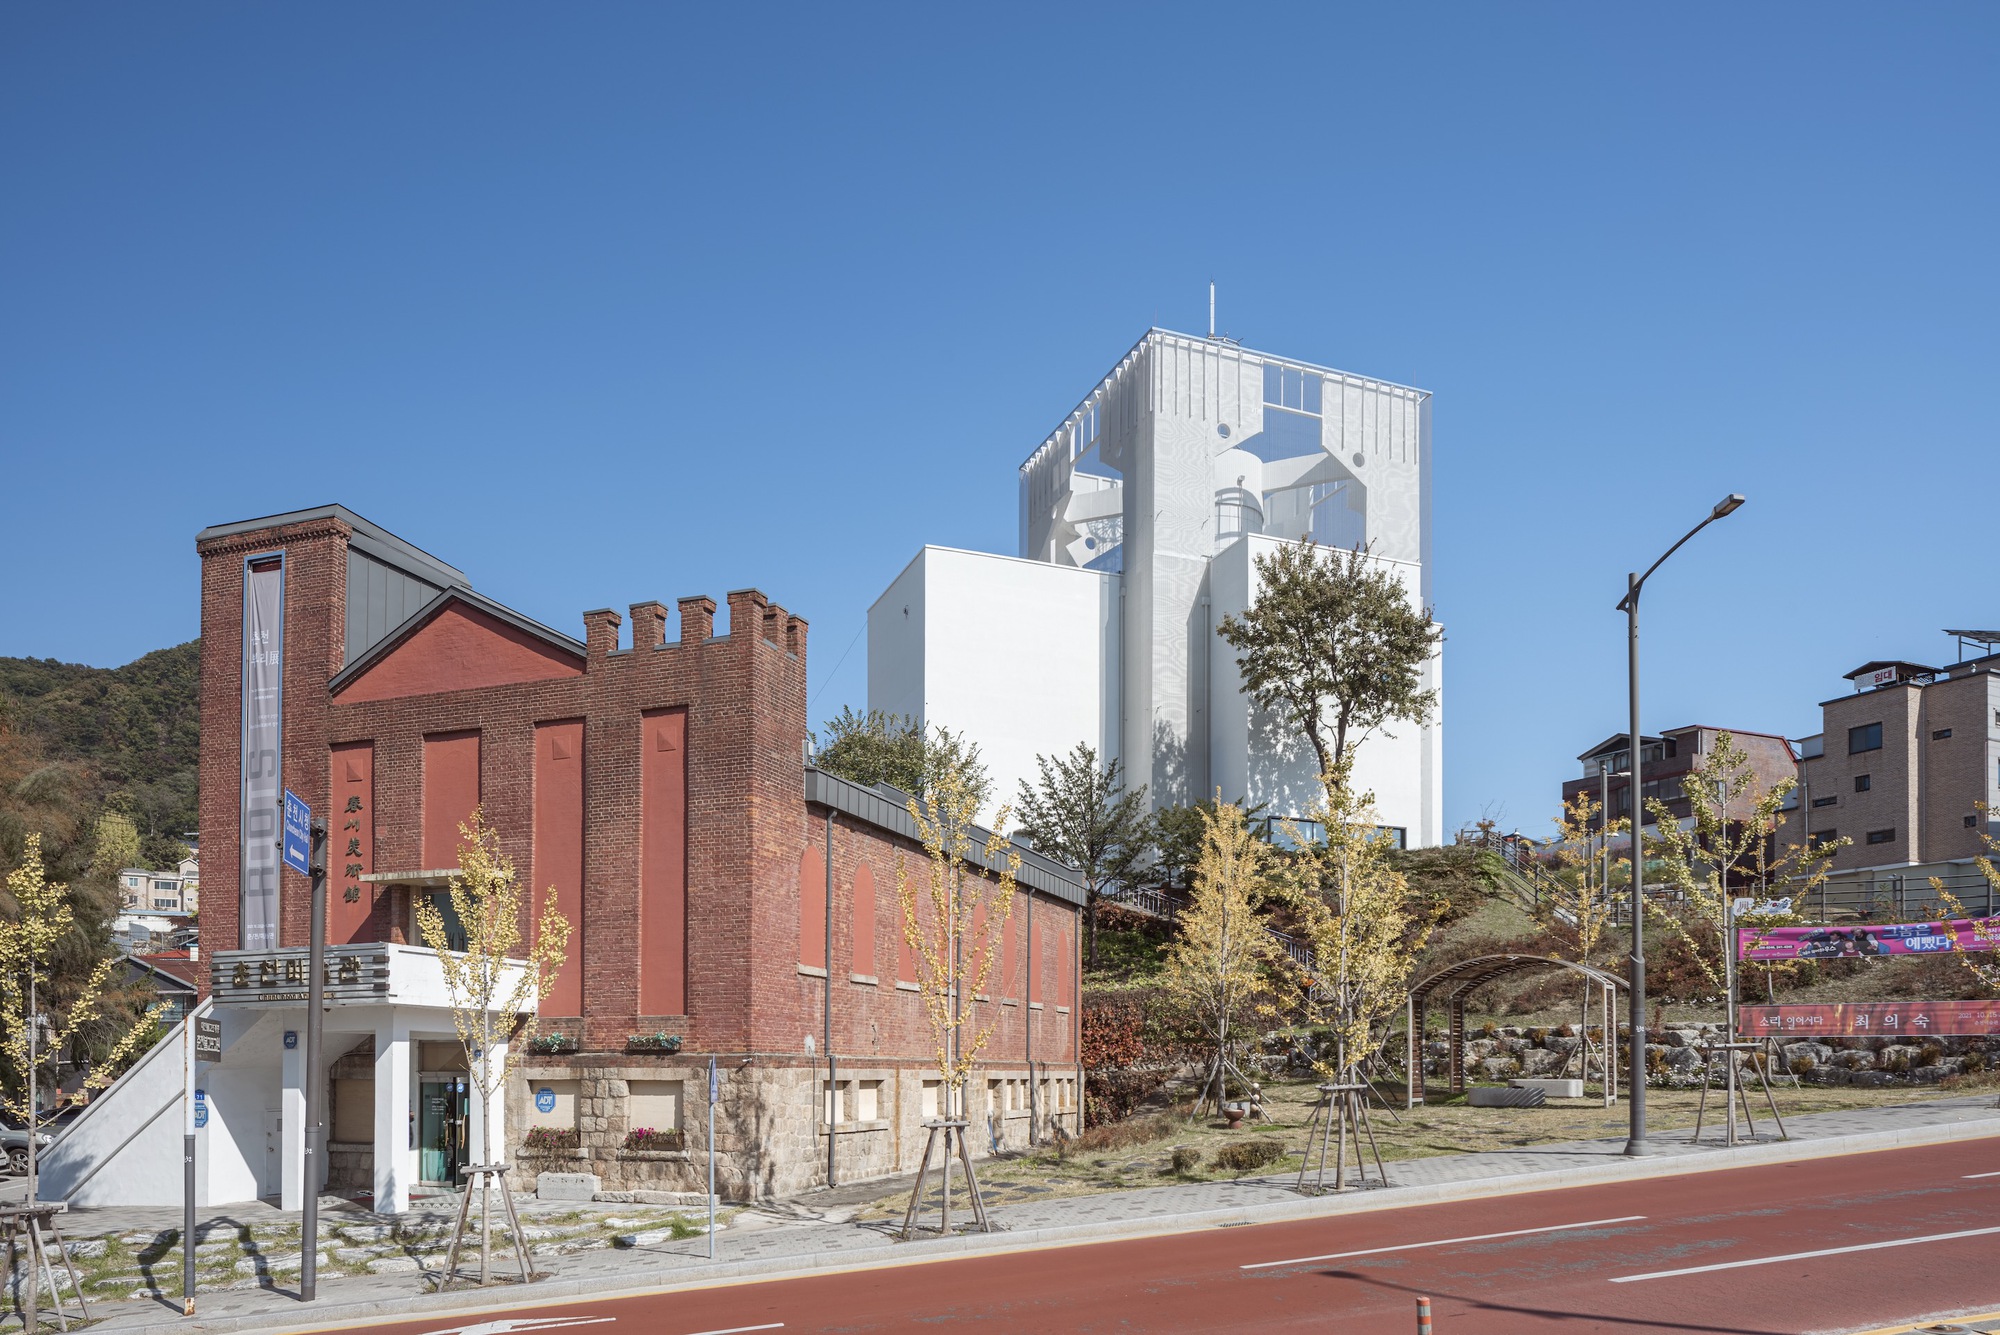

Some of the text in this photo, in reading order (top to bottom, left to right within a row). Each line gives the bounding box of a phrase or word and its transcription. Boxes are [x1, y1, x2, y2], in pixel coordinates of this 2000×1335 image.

[1874, 670, 1892, 683] 임대
[286, 799, 309, 831] 춘천시청
[247, 749, 276, 898] ROOTS
[1882, 924, 1931, 938] 그놈은
[1905, 936, 1953, 950] 예뻤다
[539, 1095, 553, 1105] ADT
